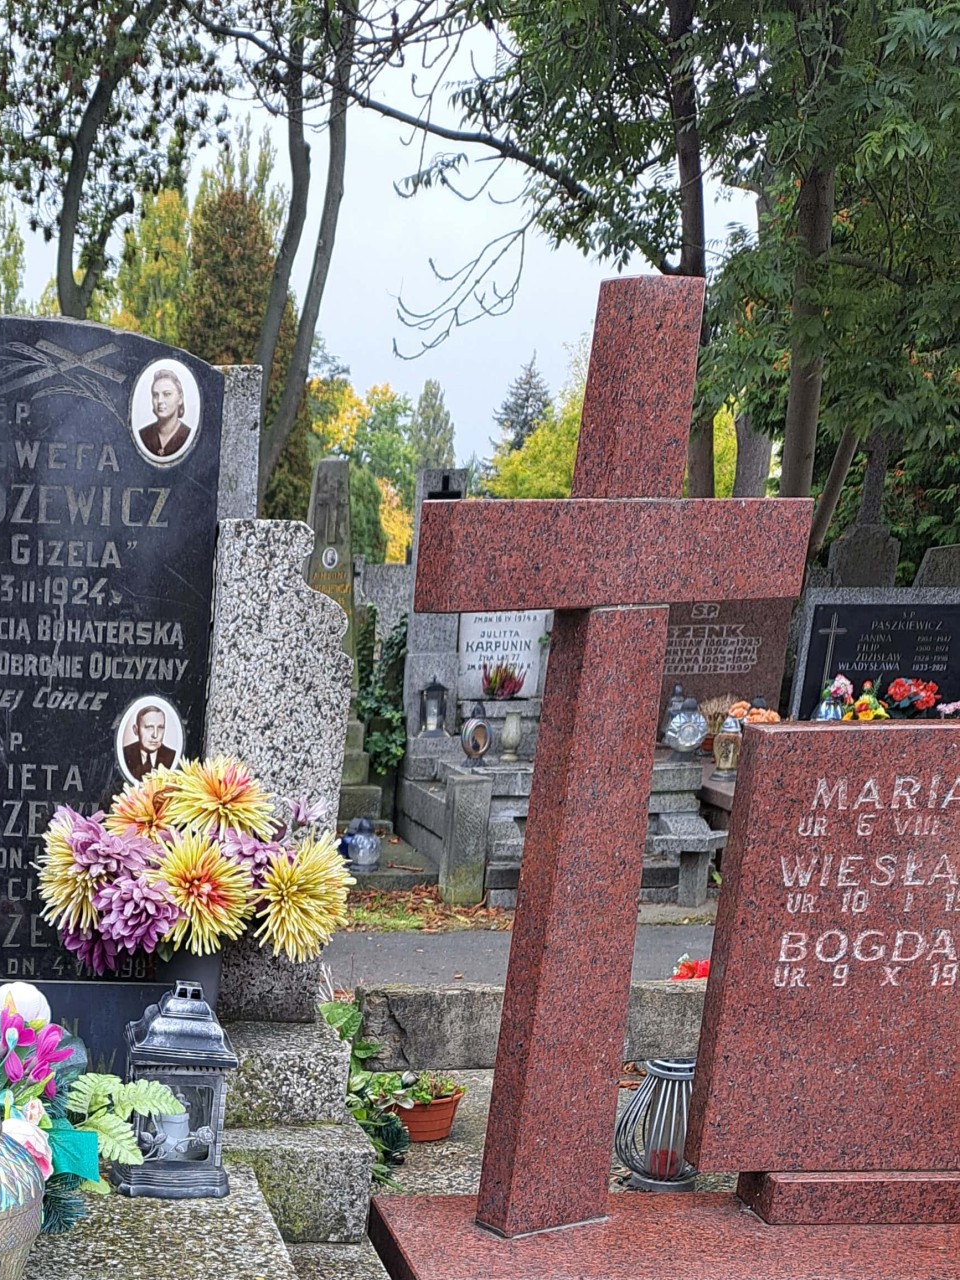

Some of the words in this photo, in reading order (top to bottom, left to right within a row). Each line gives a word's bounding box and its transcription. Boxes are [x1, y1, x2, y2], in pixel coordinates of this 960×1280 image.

[37, 614, 185, 650] BOHATERSKĄ
[871, 620, 944, 631] PASZKIEWICZ
[480, 629, 520, 639] JULITTA
[858, 633, 893, 643] JANINA
[465, 639, 532, 653] KARPUNIN
[856, 643, 881, 652] FILIP
[89, 654, 189, 682] OJCZYZNY
[841, 888, 869, 914] 10
[832, 963, 850, 987] 9
